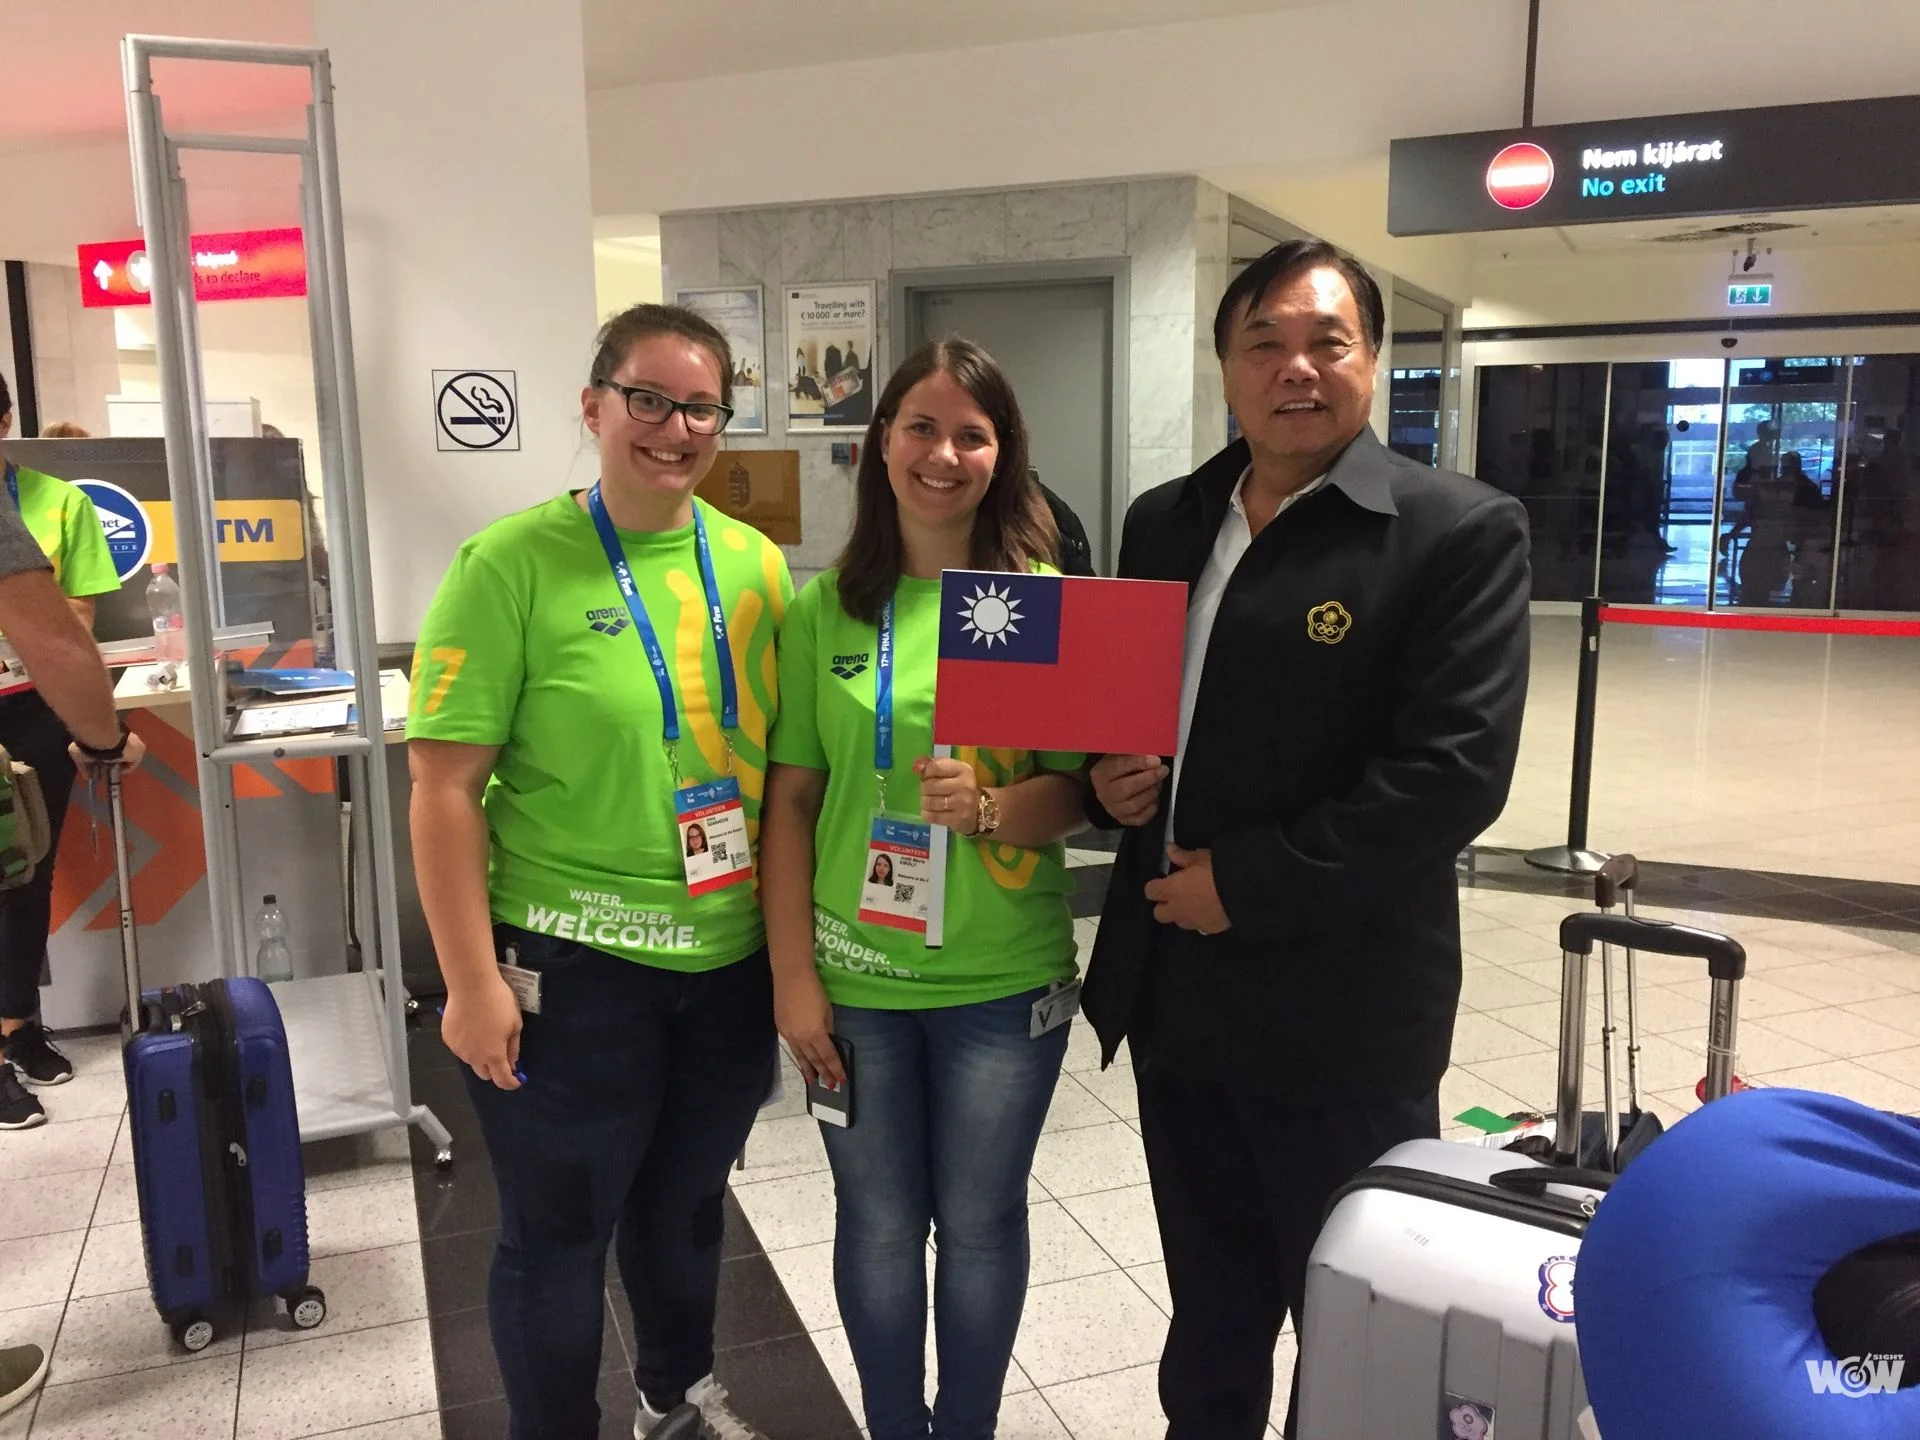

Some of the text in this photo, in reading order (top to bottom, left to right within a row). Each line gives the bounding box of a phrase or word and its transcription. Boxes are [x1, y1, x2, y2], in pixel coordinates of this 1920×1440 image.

[1582, 140, 1723, 170] Nem kijárat
[1582, 172, 1666, 197] No exit
[220, 269, 261, 284] declare
[814, 299, 866, 311] Travelling with
[843, 309, 866, 318] more?
[98, 518, 121, 528] net
[216, 518, 275, 544] TM
[585, 607, 628, 621] arena
[882, 601, 891, 630] WORL
[881, 631, 890, 652] FINA
[832, 652, 870, 665] arena
[568, 888, 625, 907] WATER.
[581, 903, 676, 926] WONDER.
[525, 903, 702, 951] WELCOME.
